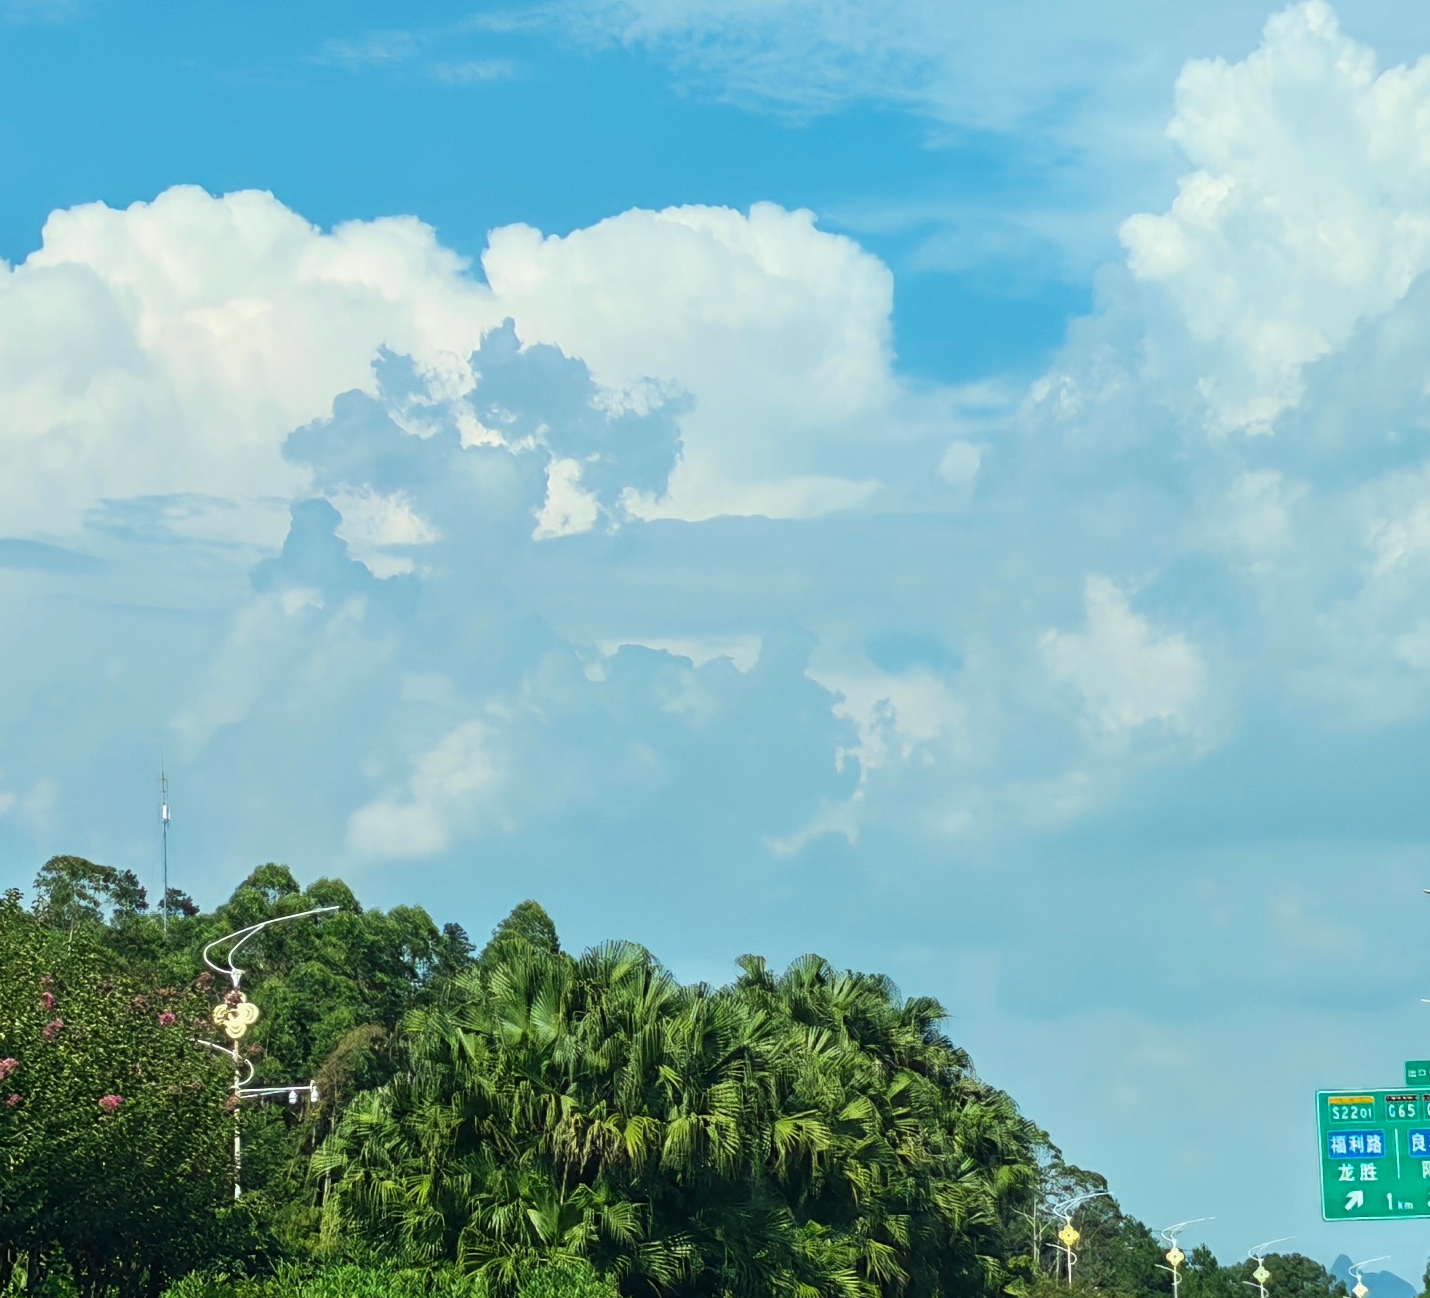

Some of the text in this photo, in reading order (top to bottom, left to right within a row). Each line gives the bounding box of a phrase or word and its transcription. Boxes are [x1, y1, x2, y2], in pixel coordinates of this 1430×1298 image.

[1332, 1105, 1372, 1120] S2201
[1388, 1104, 1416, 1118] G65
[1330, 1134, 1382, 1154] 福利路
[1338, 1162, 1378, 1182] 龙胜
